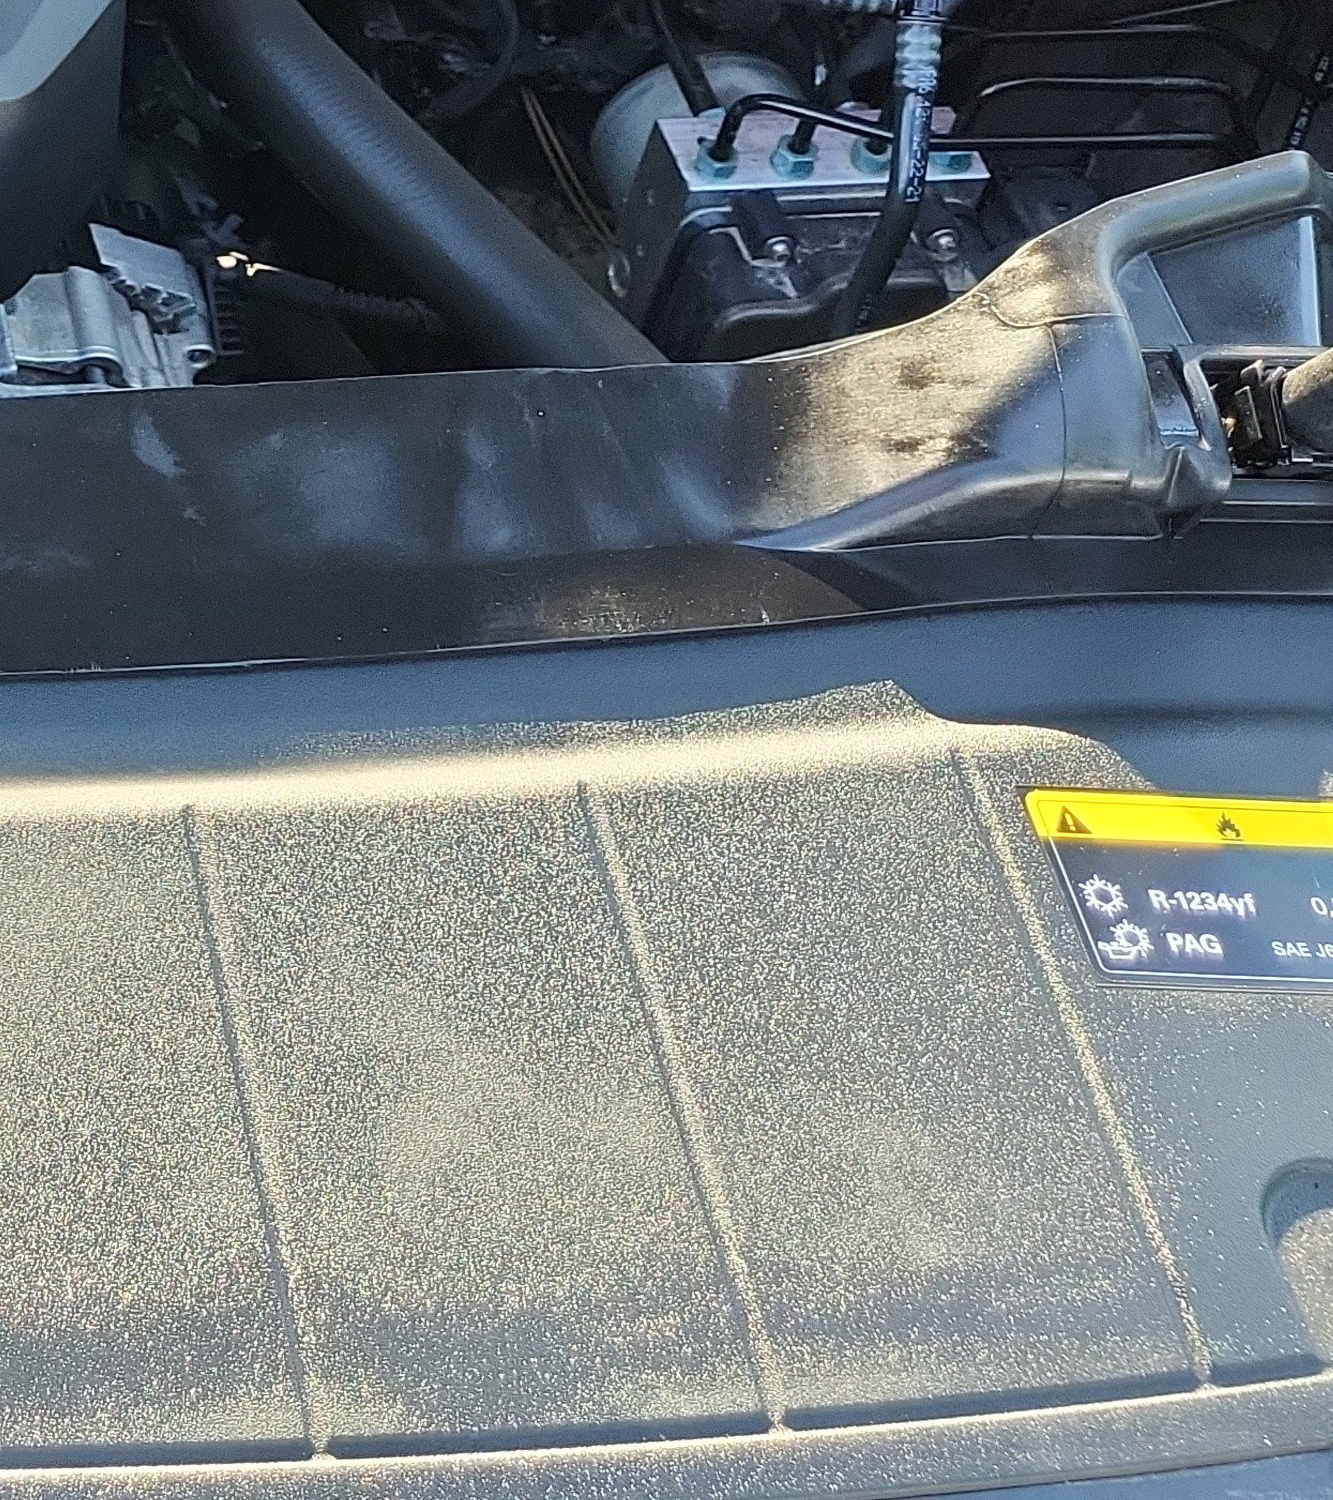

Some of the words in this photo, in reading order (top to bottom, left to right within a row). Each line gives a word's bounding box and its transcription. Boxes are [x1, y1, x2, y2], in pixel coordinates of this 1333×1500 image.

[1147, 888, 1257, 921] R-1234yf
[1165, 932, 1223, 956] PAG
[1272, 941, 1312, 959] SAE
